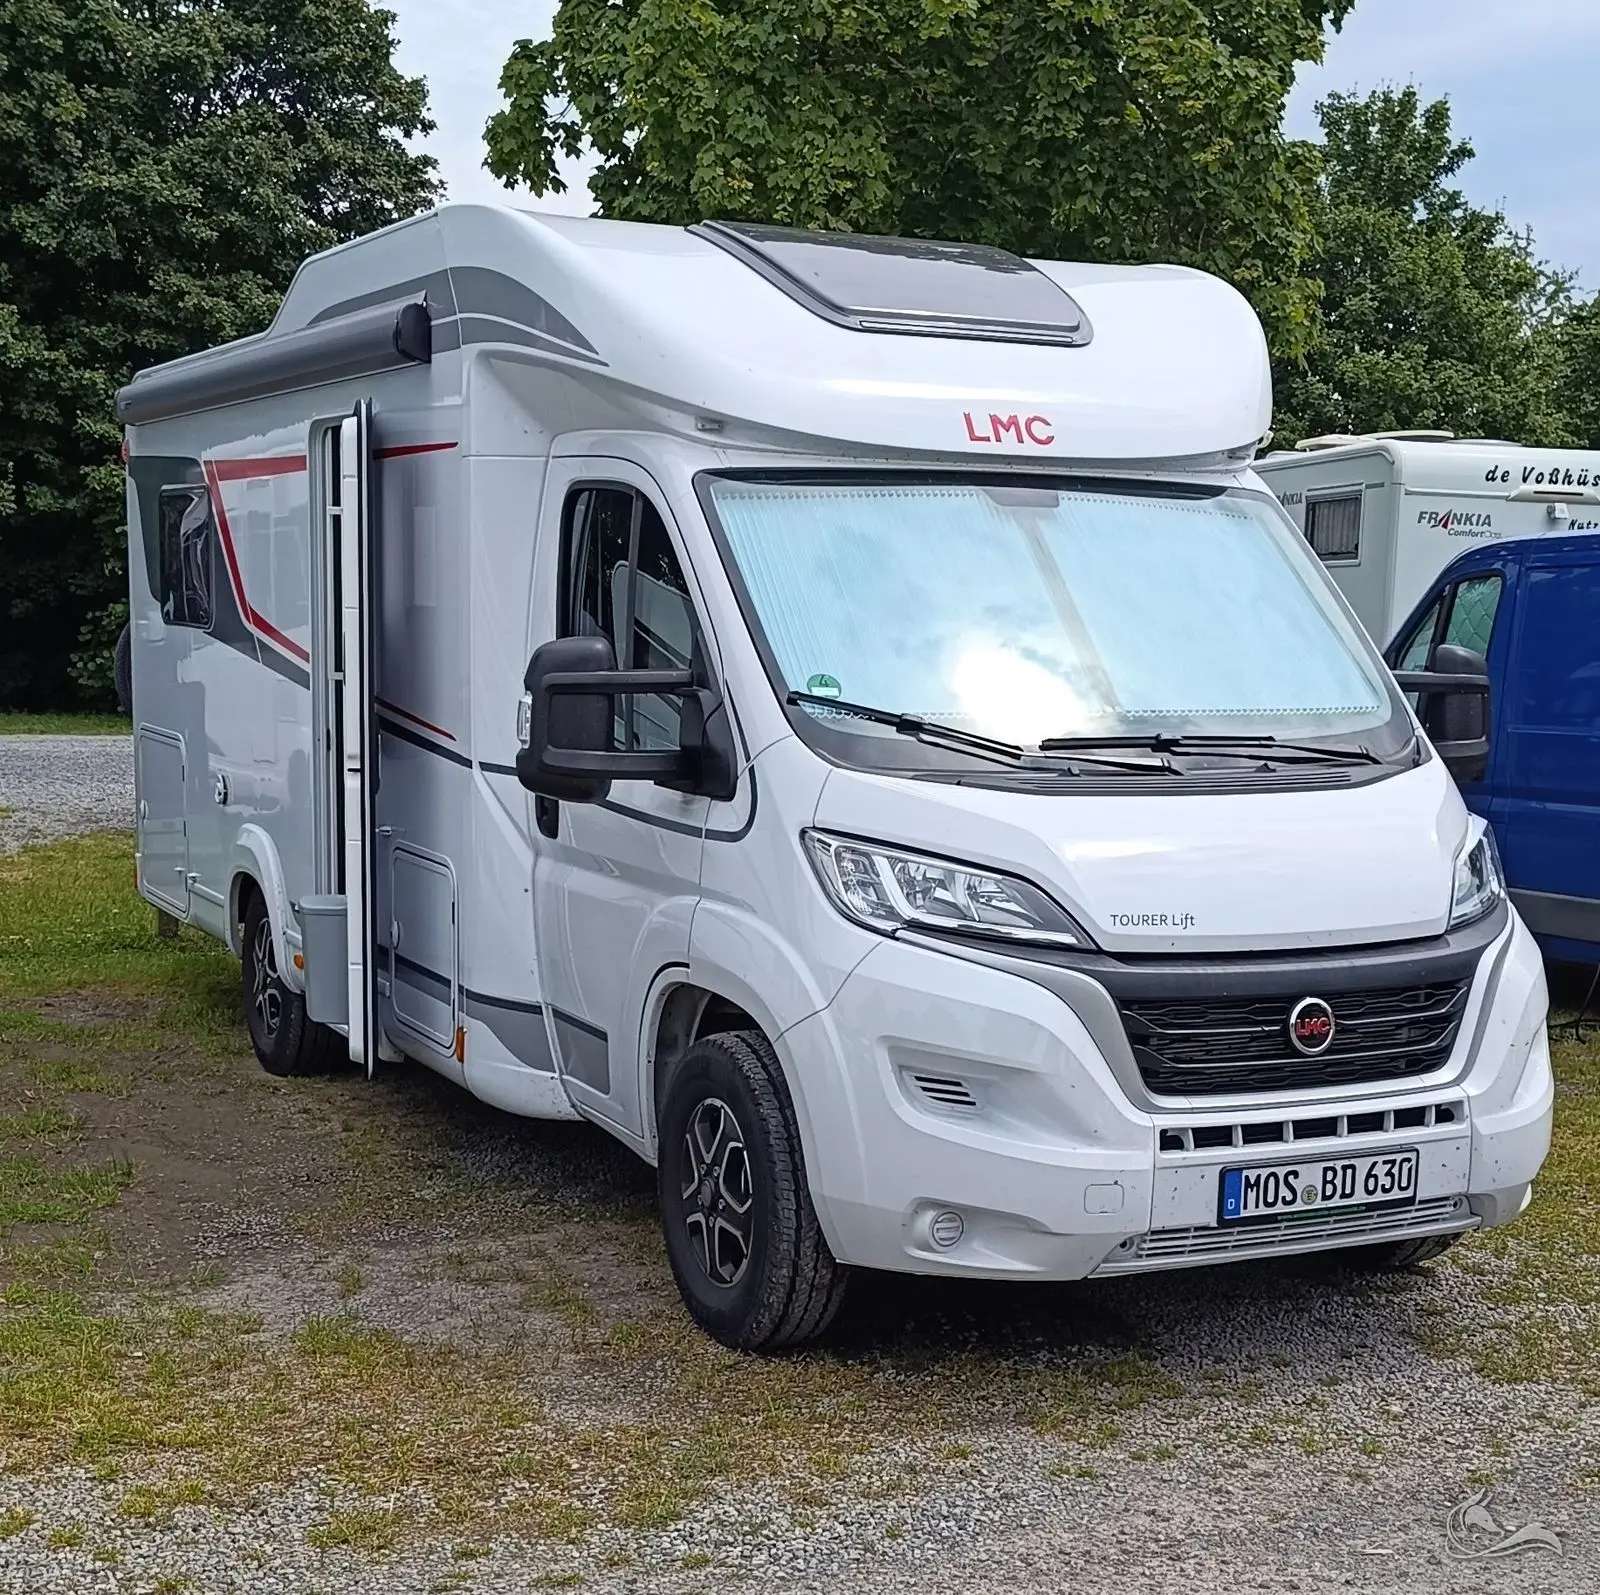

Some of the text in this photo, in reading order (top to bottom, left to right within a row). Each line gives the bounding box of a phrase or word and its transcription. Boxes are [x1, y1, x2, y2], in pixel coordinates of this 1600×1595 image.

[963, 411, 1054, 445] LMC
[1484, 464, 1510, 483] de
[1417, 509, 1492, 529] FRANKIA
[1110, 913, 1196, 930] TOURER Lift
[1295, 1016, 1331, 1036] LMC
[1227, 1157, 1414, 1211] D MOS BD 630
